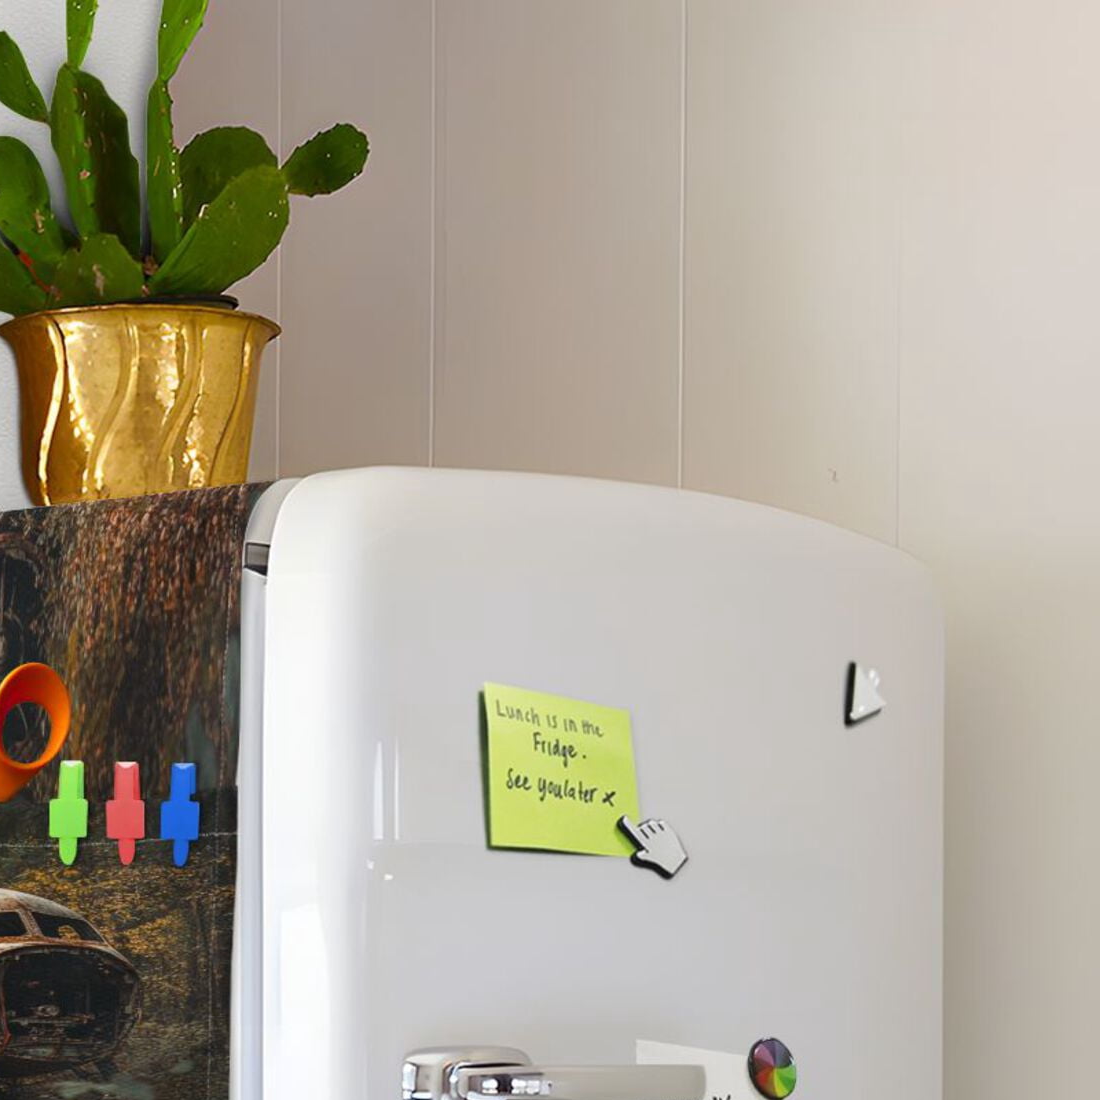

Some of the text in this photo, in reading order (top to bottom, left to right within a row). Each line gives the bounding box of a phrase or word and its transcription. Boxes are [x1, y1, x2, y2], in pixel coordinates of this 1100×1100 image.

[496, 699, 540, 726] Lunch
[564, 718, 578, 732] in
[582, 720, 604, 737] the
[506, 768, 532, 791] See
